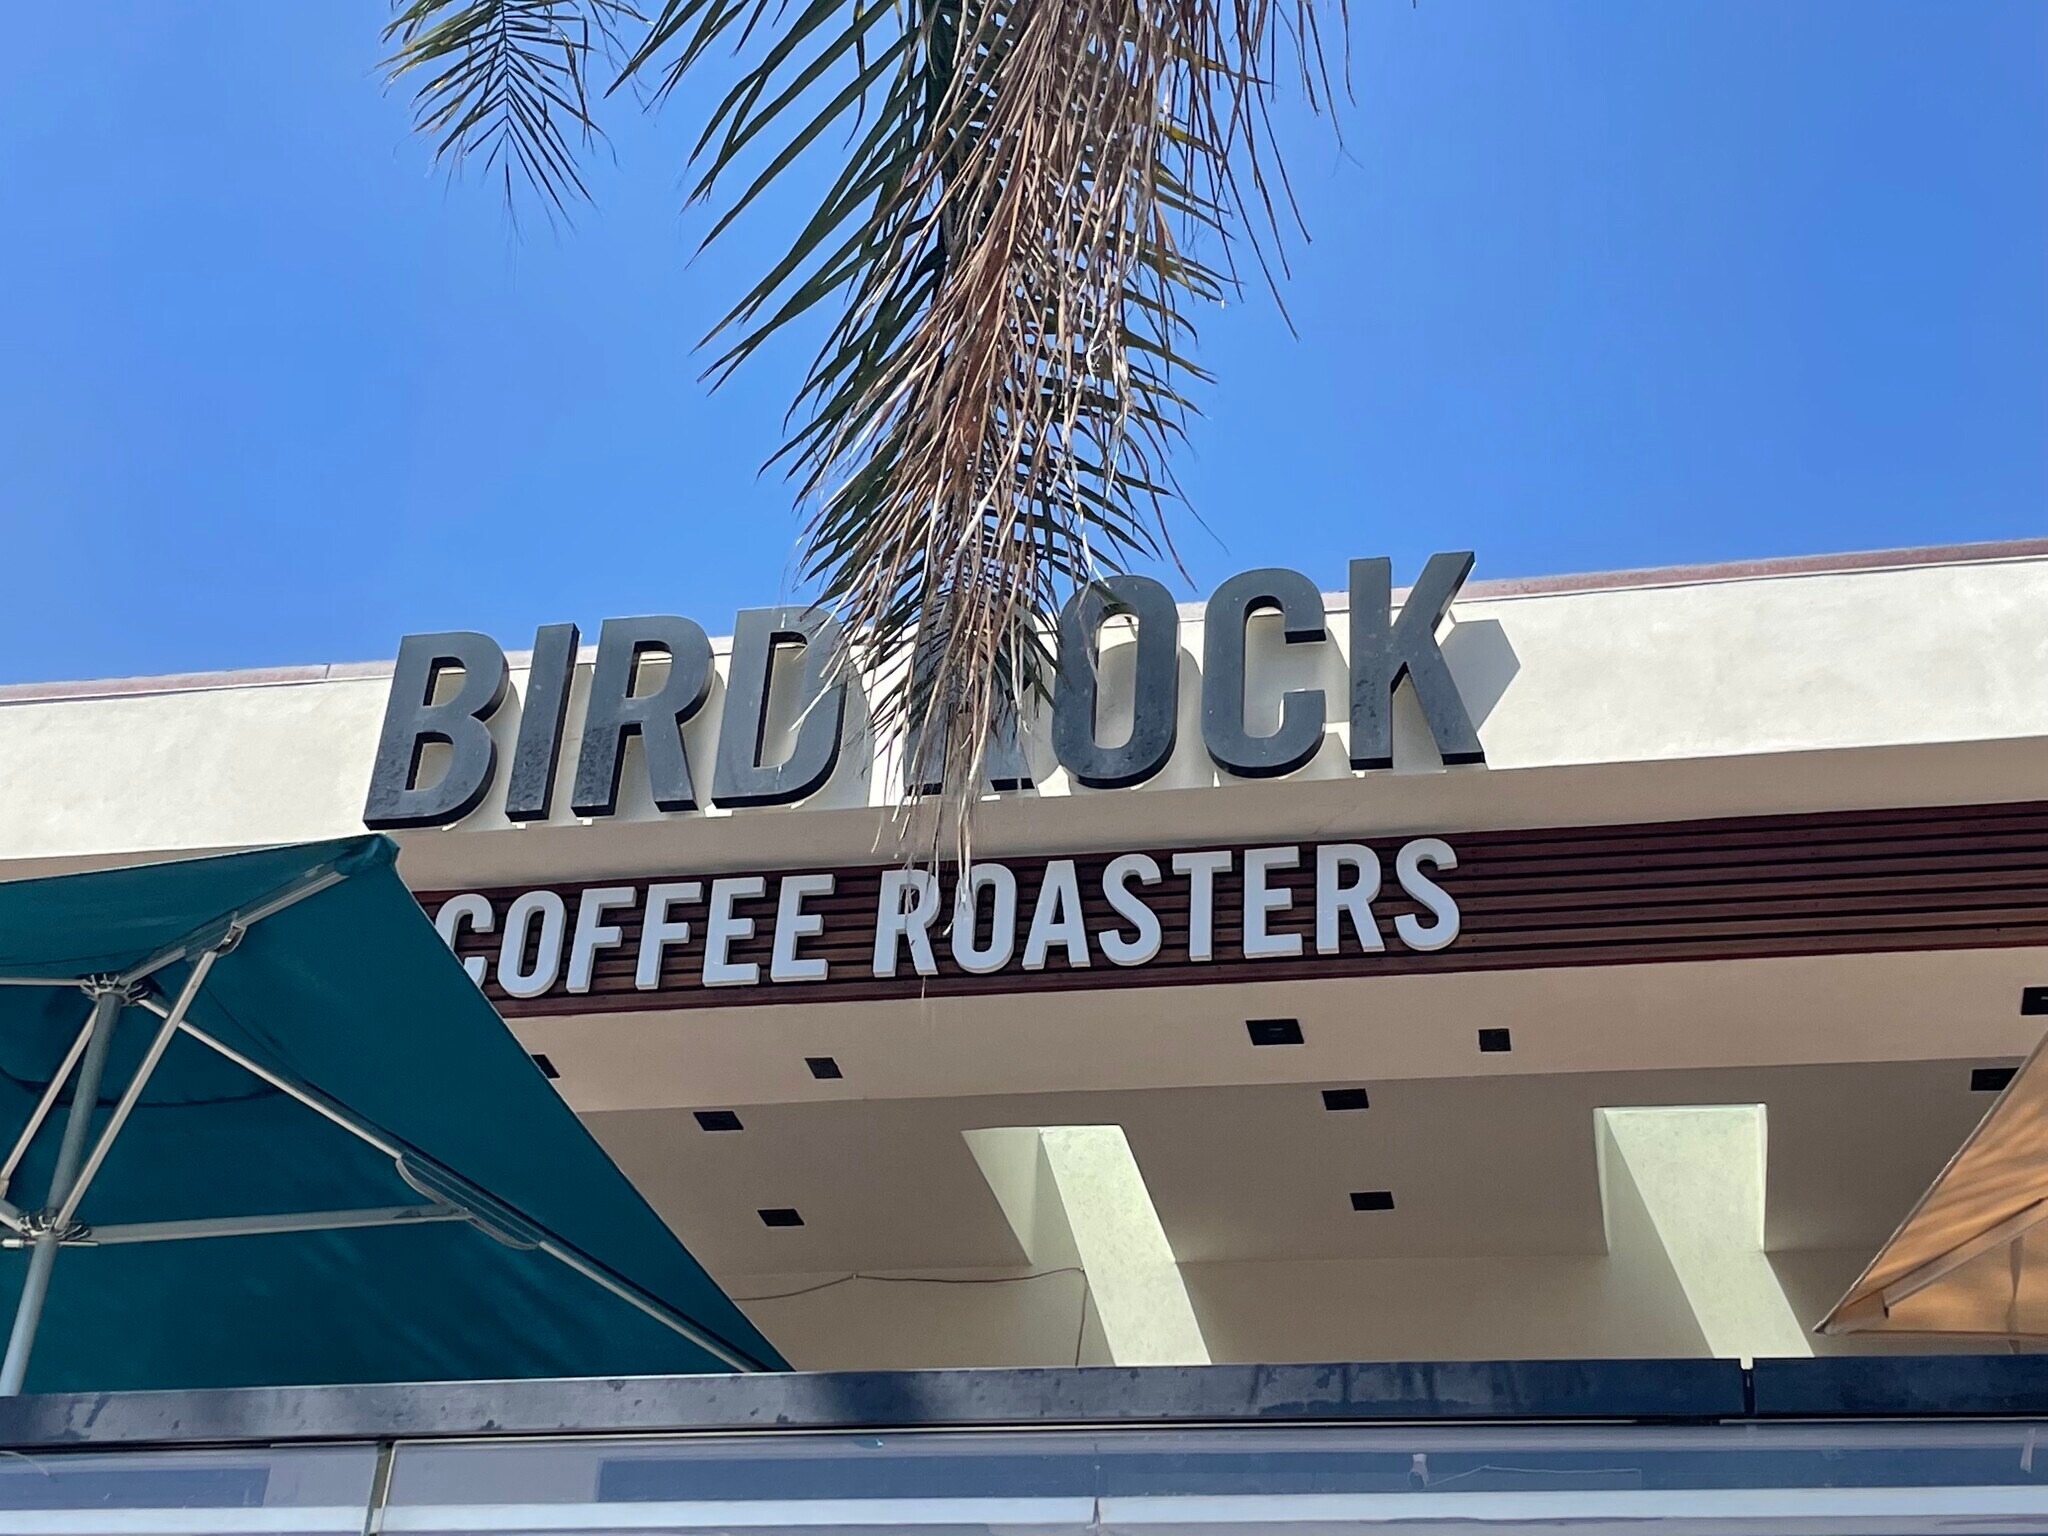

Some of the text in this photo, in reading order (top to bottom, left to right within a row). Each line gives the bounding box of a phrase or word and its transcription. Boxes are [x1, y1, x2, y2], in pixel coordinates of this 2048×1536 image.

[363, 606, 849, 830] BIRD
[434, 838, 1460, 998] COFFEE ROASTERS
